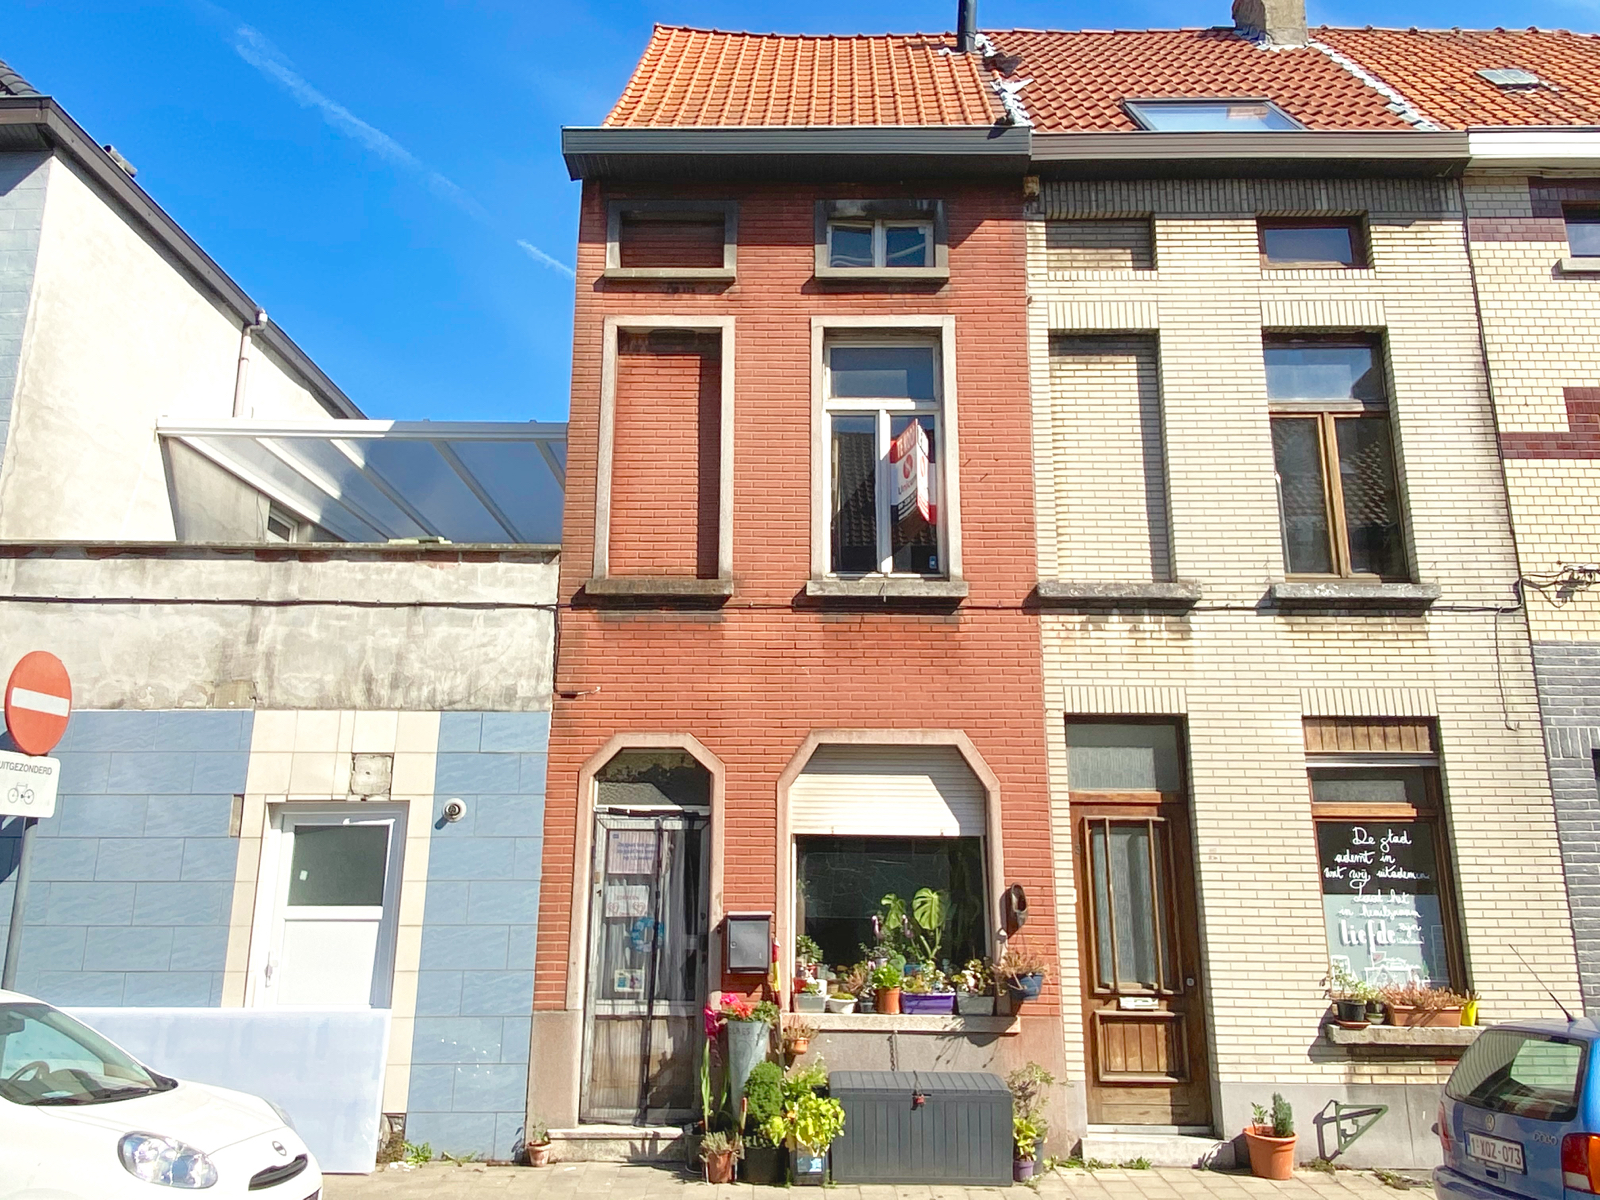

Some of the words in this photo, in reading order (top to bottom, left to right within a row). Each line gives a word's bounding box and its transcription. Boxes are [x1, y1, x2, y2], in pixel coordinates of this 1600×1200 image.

[0, 761, 52, 775] UITGEZONDERD
[1352, 826, 1375, 845] De
[1380, 828, 1412, 853] stad
[1334, 849, 1375, 864] ademt
[1379, 852, 1396, 864] in
[1340, 919, 1396, 952] liefde
